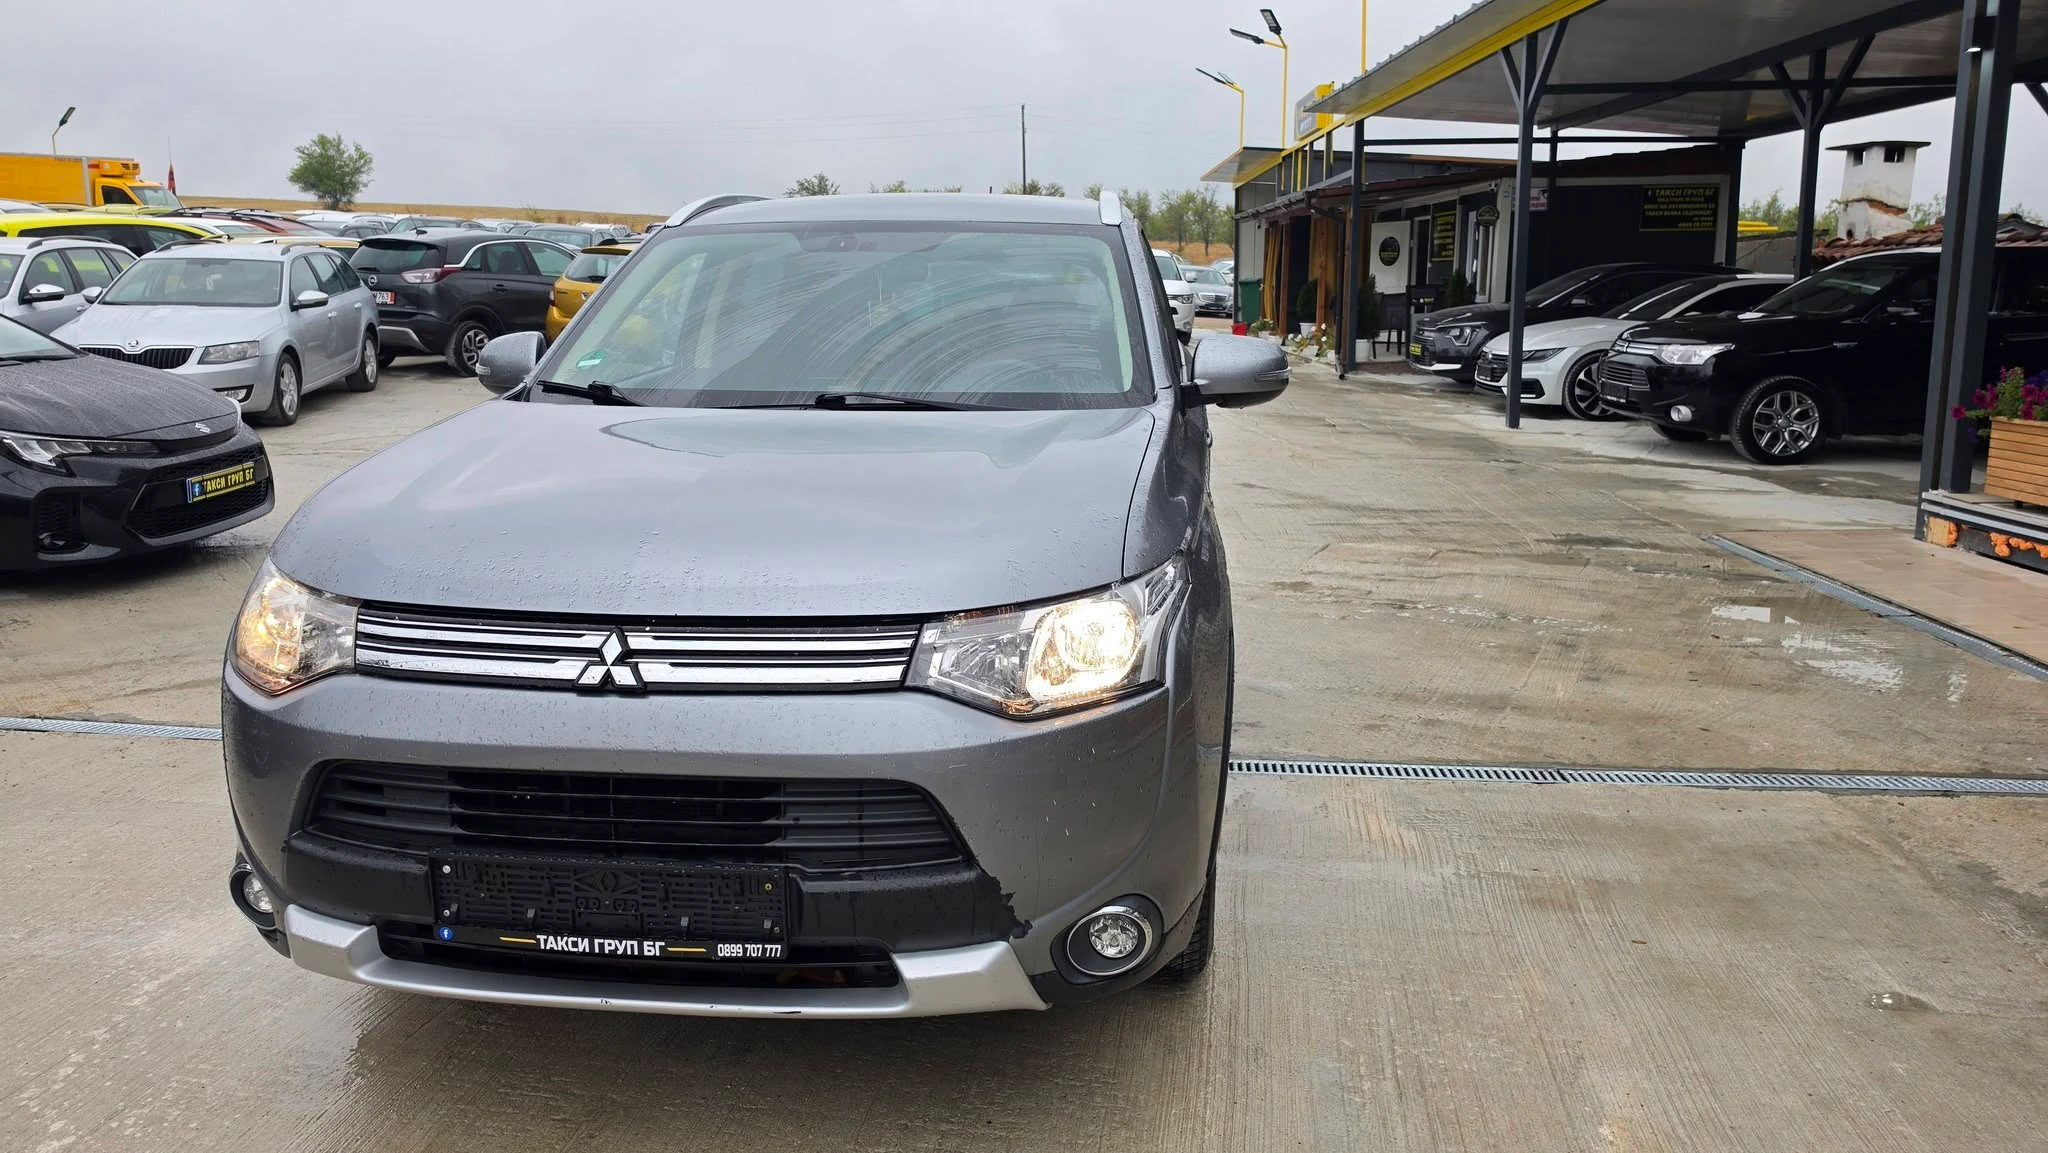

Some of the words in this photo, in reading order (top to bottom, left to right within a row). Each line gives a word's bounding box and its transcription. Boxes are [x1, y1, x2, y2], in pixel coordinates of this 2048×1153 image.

[228, 470, 244, 486] ГРУП
[245, 468, 254, 481] БГ
[536, 935, 590, 953] ТАКСИ
[594, 938, 639, 955] ГРУП
[643, 941, 665, 956] БГ
[717, 944, 743, 957] 0899
[744, 944, 762, 957] 707
[764, 945, 781, 957] 777
